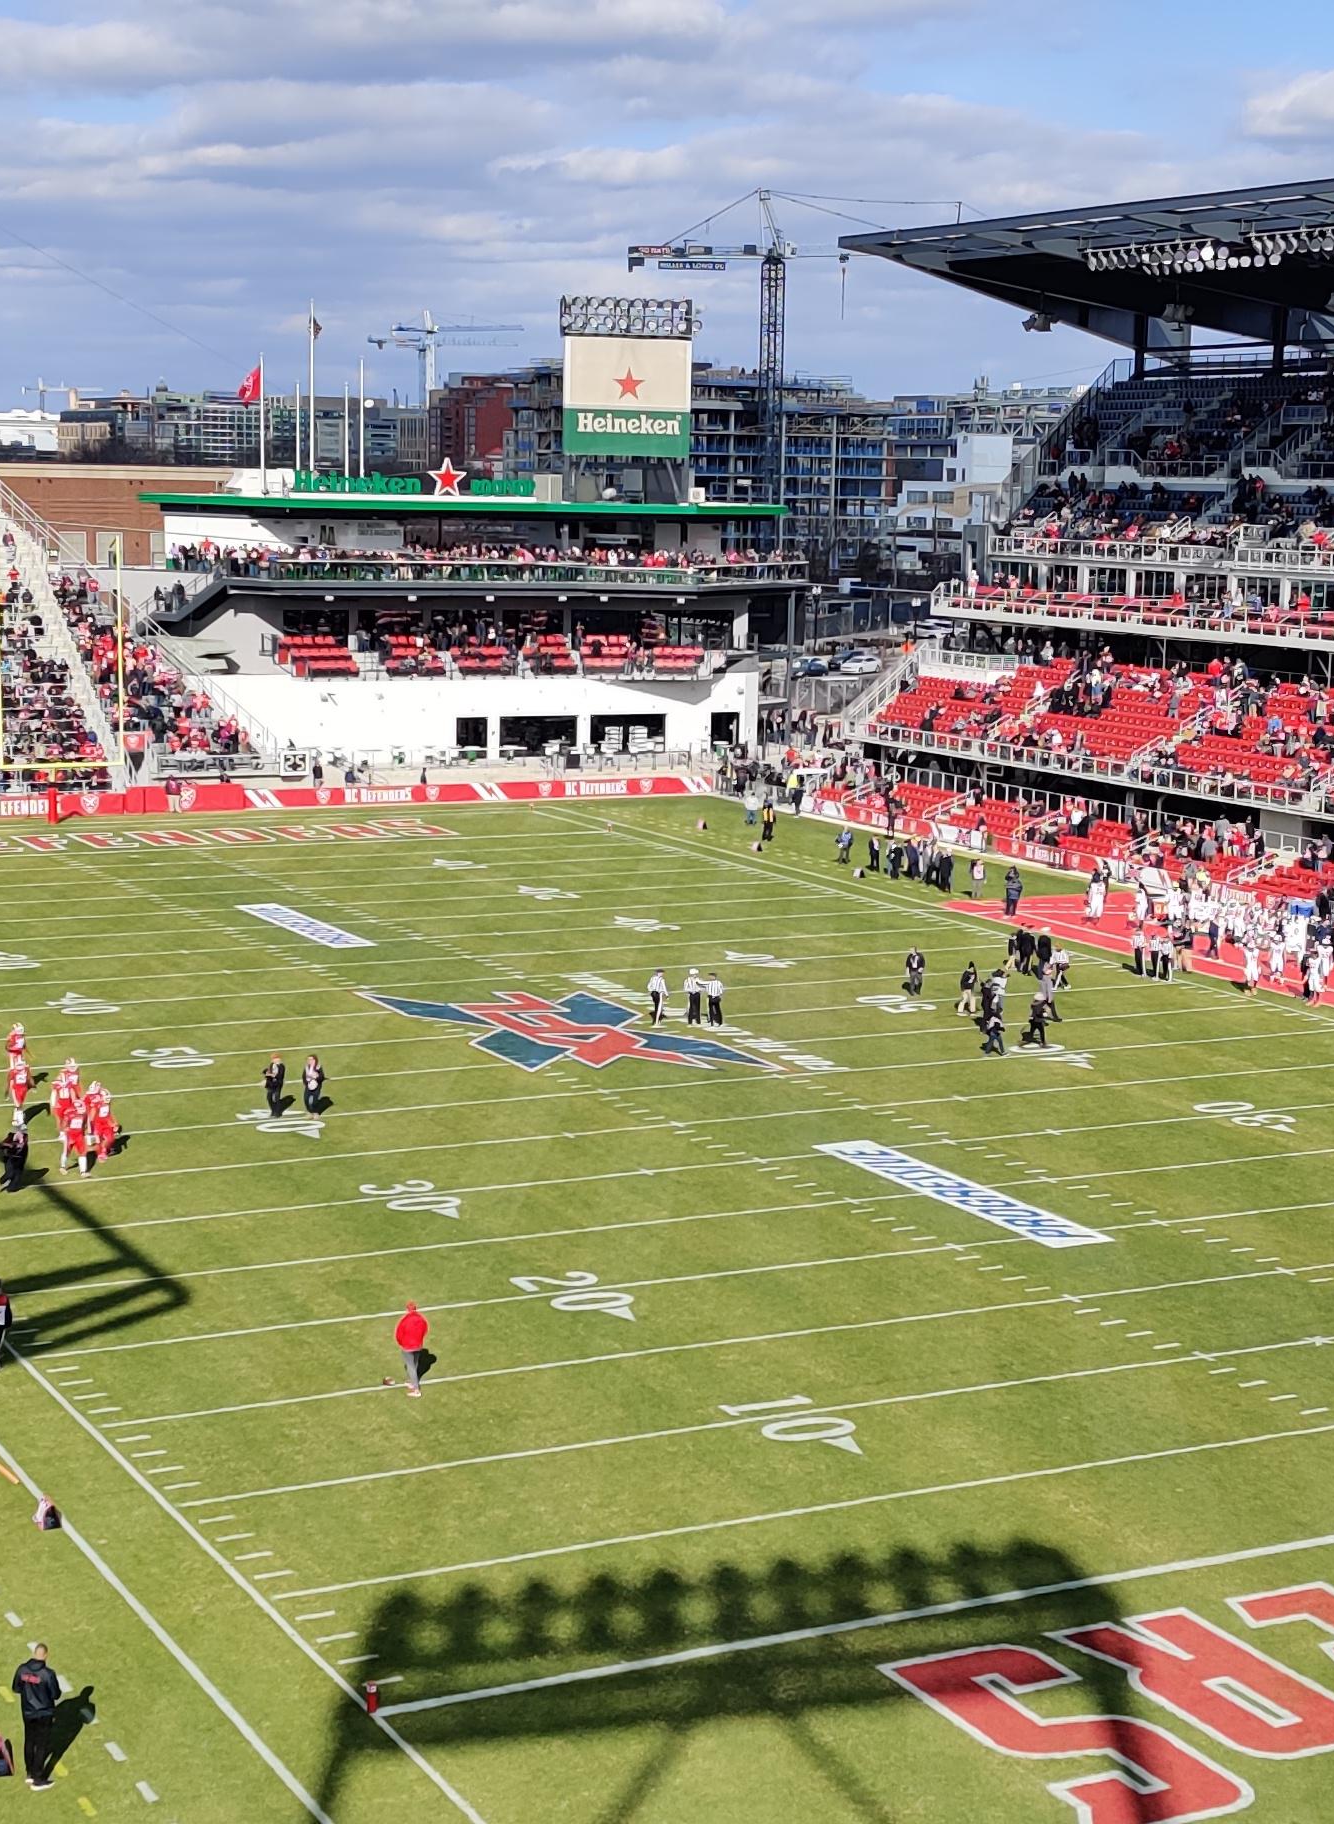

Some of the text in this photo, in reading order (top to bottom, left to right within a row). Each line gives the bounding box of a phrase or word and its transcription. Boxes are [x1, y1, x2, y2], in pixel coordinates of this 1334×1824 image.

[576, 412, 682, 436] Heineken
[294, 469, 422, 495] Heineken
[283, 755, 307, 773] 25
[360, 786, 413, 803] DEFENDERS
[447, 990, 721, 1070] XFL
[130, 1046, 216, 1069] 50
[1192, 1100, 1296, 1128] 30
[358, 1179, 462, 1213] 30
[835, 1148, 1096, 1240] PROGRESSIVE
[509, 1270, 636, 1314] 20
[717, 1394, 858, 1443] 10
